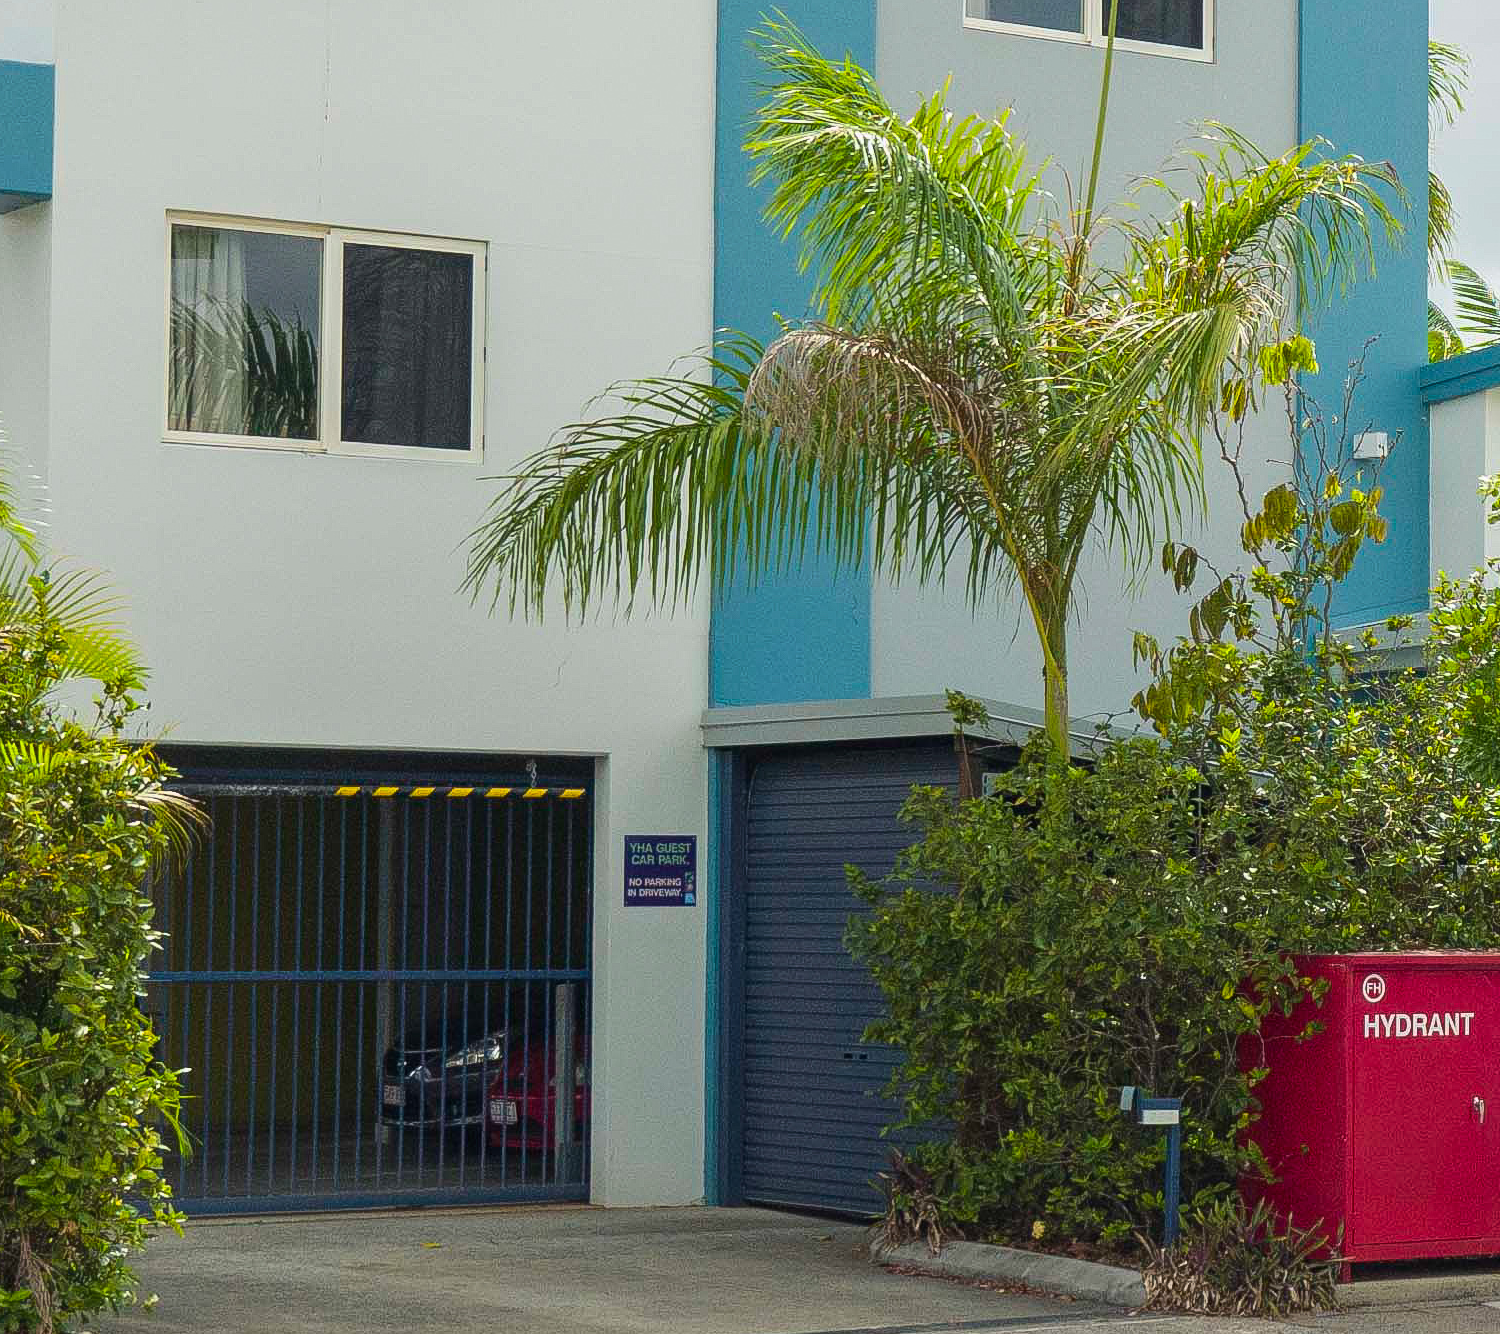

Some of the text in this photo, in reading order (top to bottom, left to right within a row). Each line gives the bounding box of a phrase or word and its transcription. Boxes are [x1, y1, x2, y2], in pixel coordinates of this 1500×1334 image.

[629, 842, 692, 854] YHA GUEST
[631, 854, 655, 865] CAR
[628, 877, 682, 887] NO PARKING
[627, 888, 637, 897] IN
[1366, 981, 1382, 994] FH
[1363, 1012, 1475, 1039] HYDRANT
